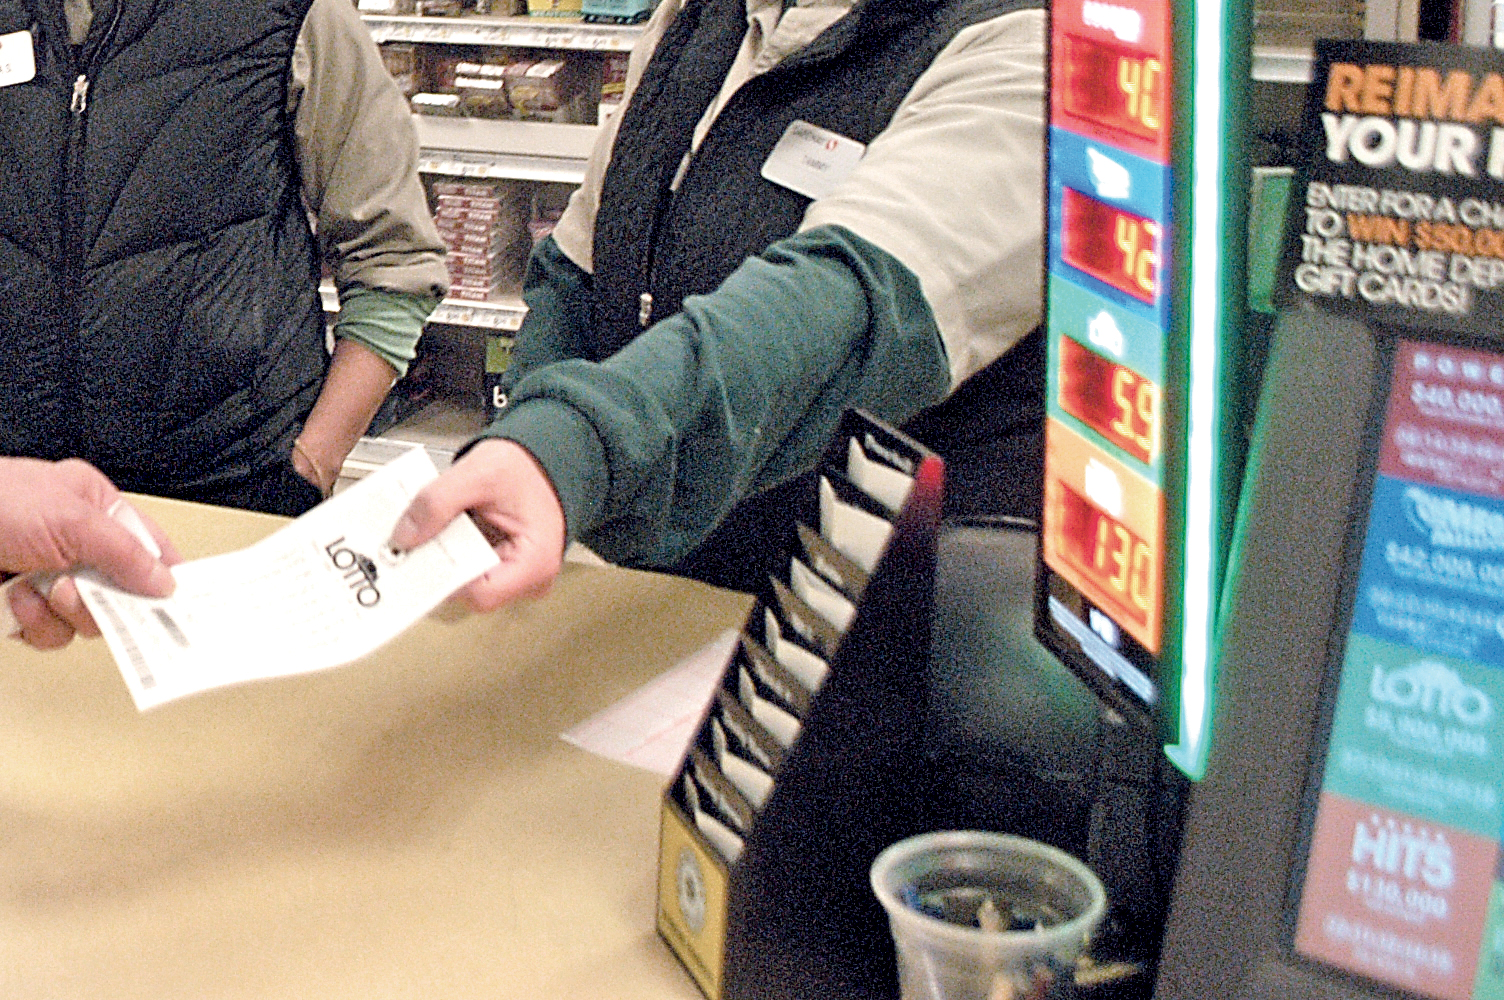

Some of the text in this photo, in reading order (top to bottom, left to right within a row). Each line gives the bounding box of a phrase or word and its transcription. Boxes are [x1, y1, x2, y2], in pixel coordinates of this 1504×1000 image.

[1325, 61, 1504, 124] REIMA
[1321, 111, 1479, 177] YOUR
[1305, 206, 1343, 239] TO
[1346, 212, 1410, 246] WIN
[1306, 181, 1380, 213] ENTER
[1380, 189, 1434, 220] FOR
[1295, 262, 1358, 298] GIFT
[1301, 234, 1352, 268] THE
[1352, 241, 1446, 281] HOME
[1112, 369, 1160, 453] 59
[324, 535, 381, 608] LOTTO
[1098, 517, 1153, 611] 130
[1369, 661, 1493, 727] LOTTO
